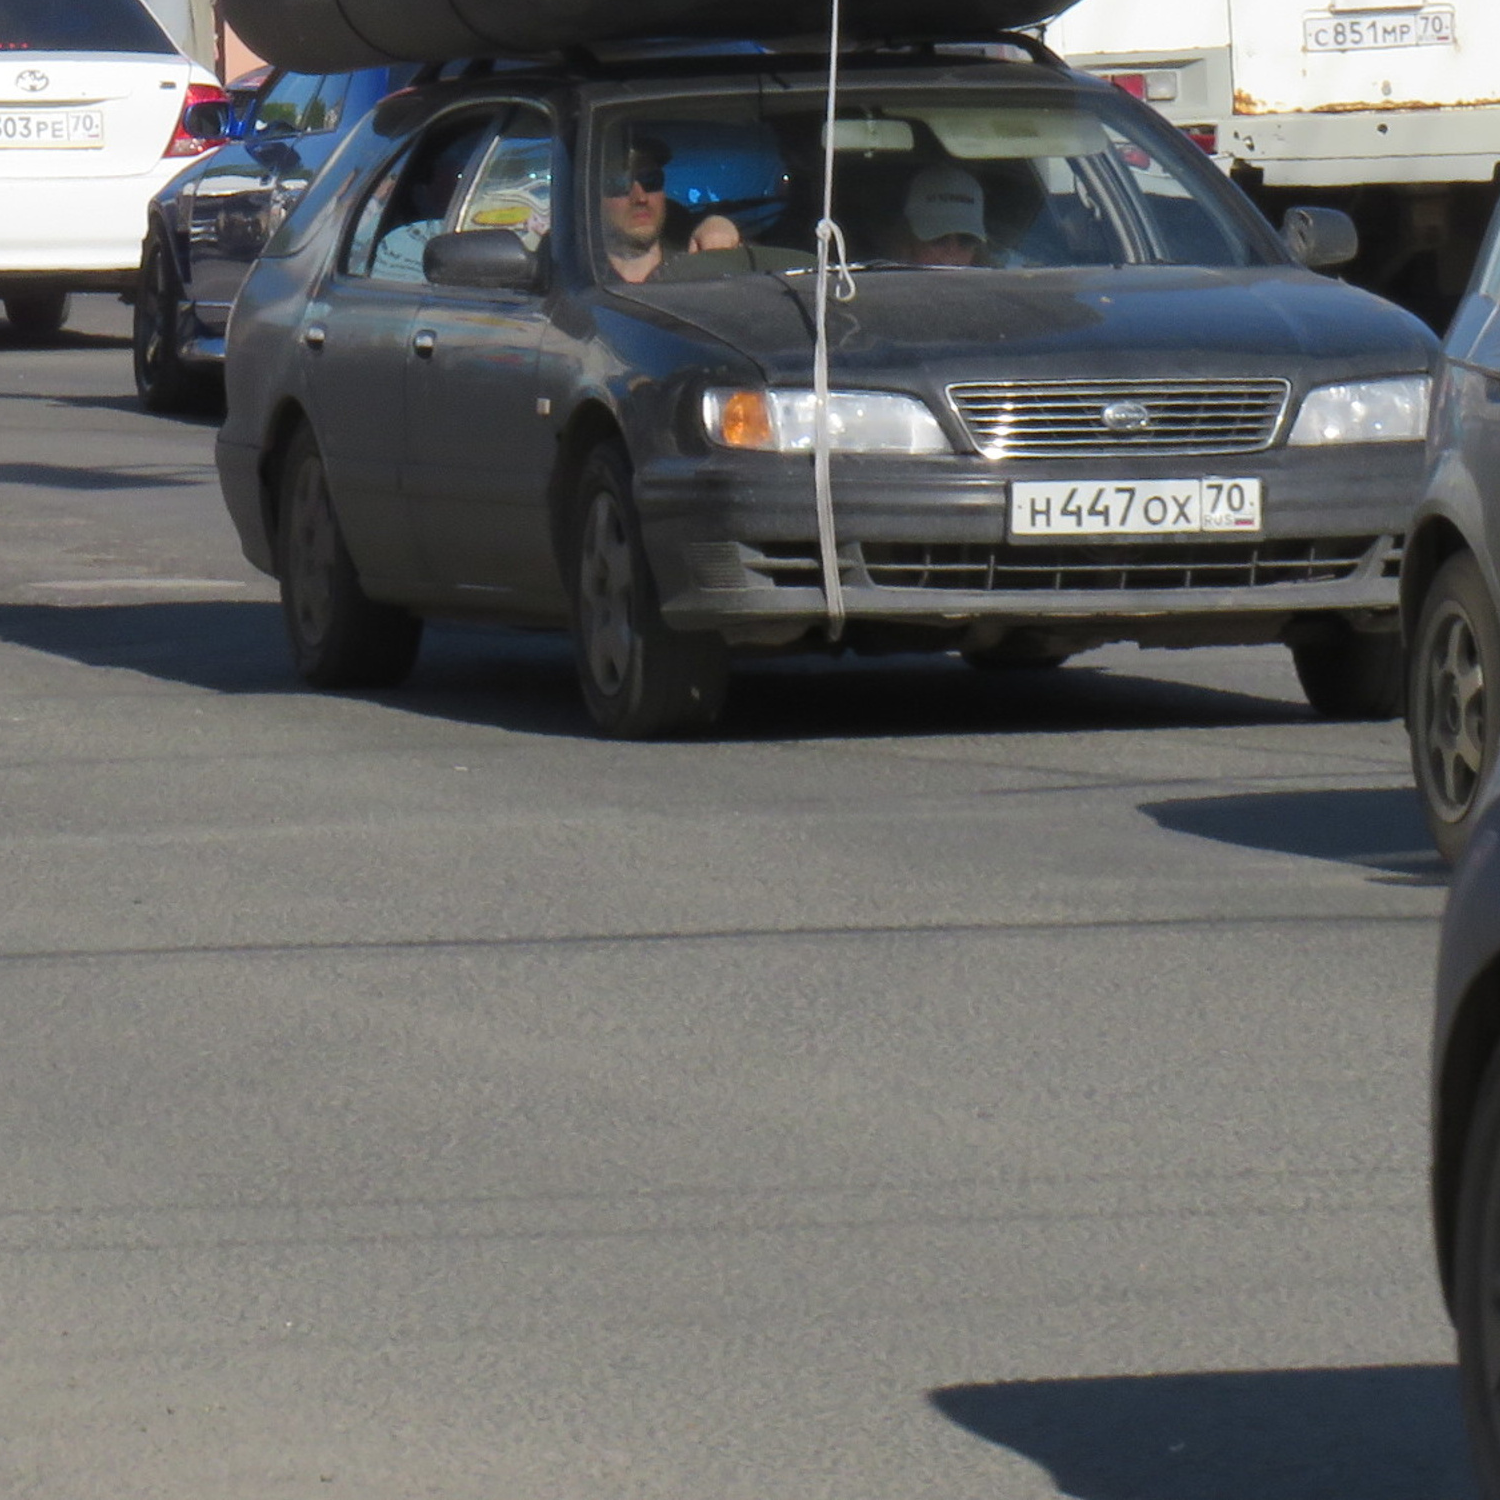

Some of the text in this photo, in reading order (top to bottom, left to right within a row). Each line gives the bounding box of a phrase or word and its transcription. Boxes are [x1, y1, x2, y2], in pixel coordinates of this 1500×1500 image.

[1419, 15, 1444, 34] 70
[71, 114, 94, 132] 70
[1206, 483, 1245, 513] 70
[1203, 514, 1233, 526] RUS
